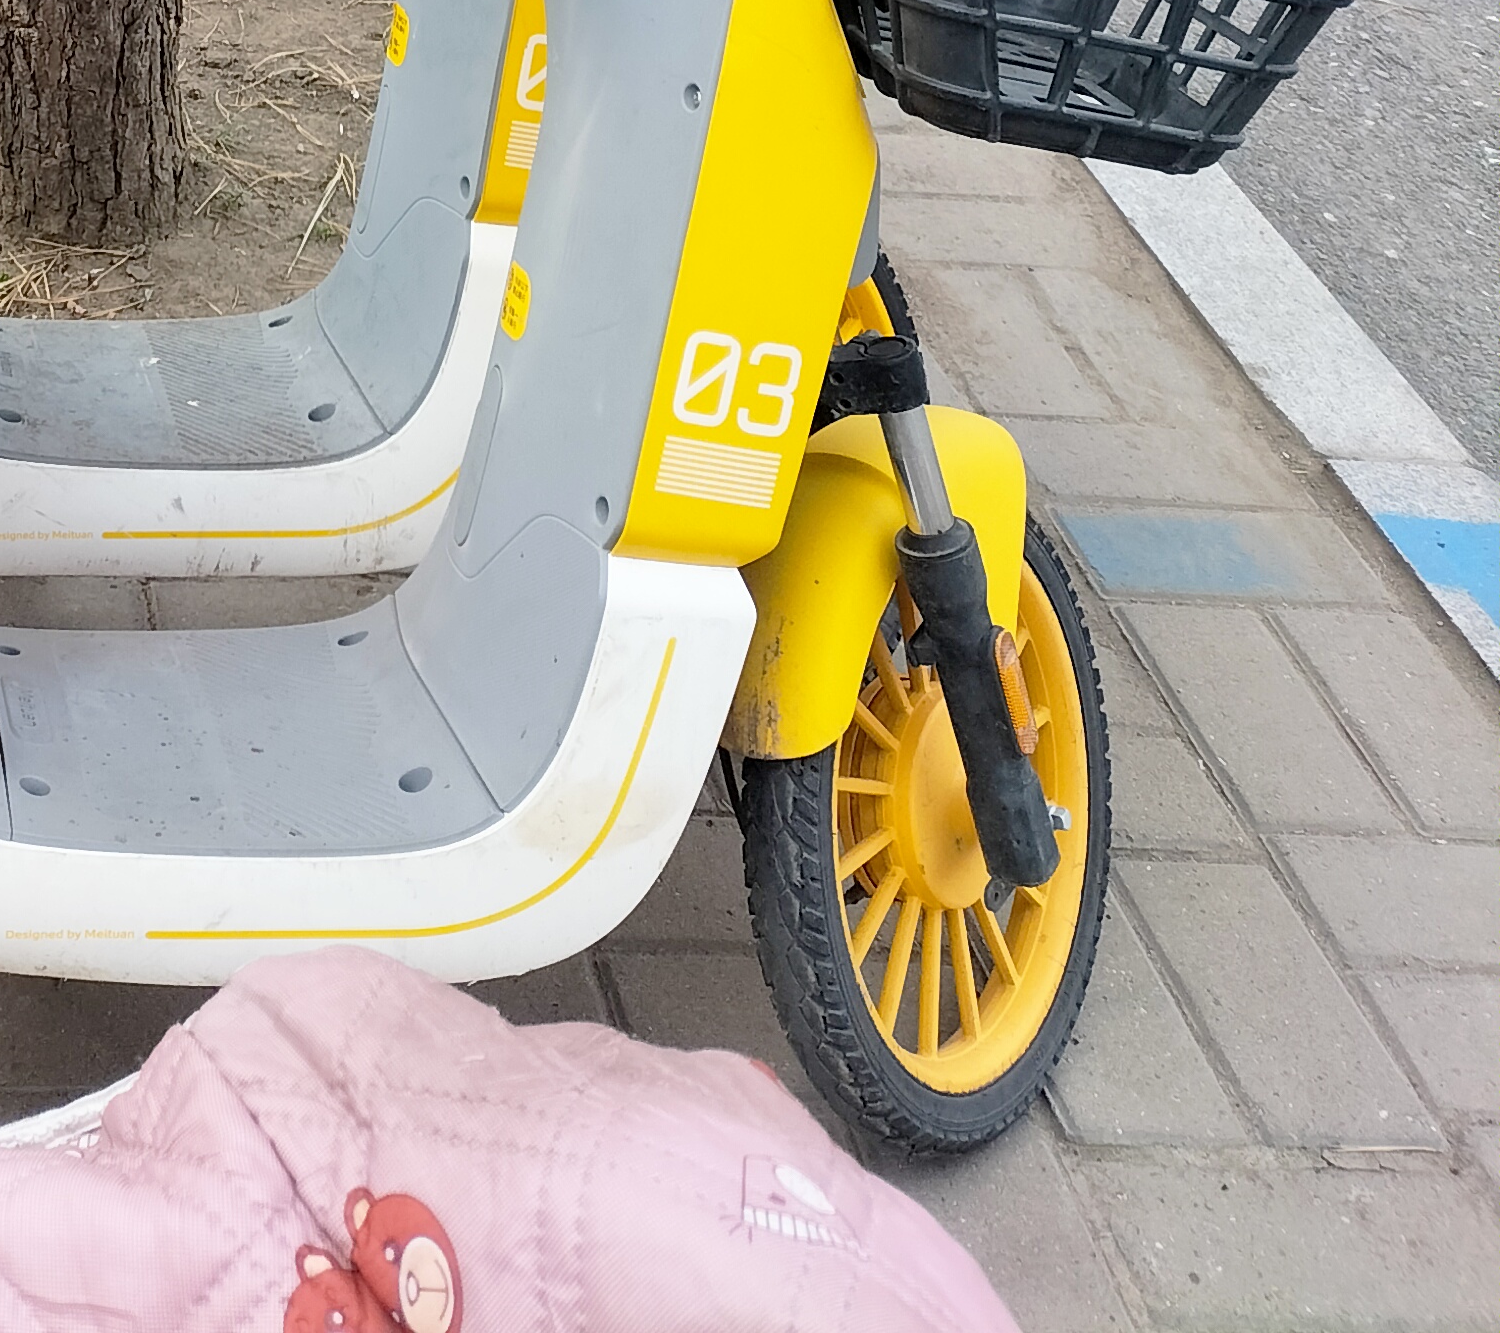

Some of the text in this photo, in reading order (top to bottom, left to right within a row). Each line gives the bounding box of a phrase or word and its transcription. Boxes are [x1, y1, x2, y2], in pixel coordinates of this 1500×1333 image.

[672, 330, 803, 438] 03
[37, 531, 50, 541] by
[51, 530, 94, 539] Meituan
[5, 928, 135, 941] Designed by Meituan
